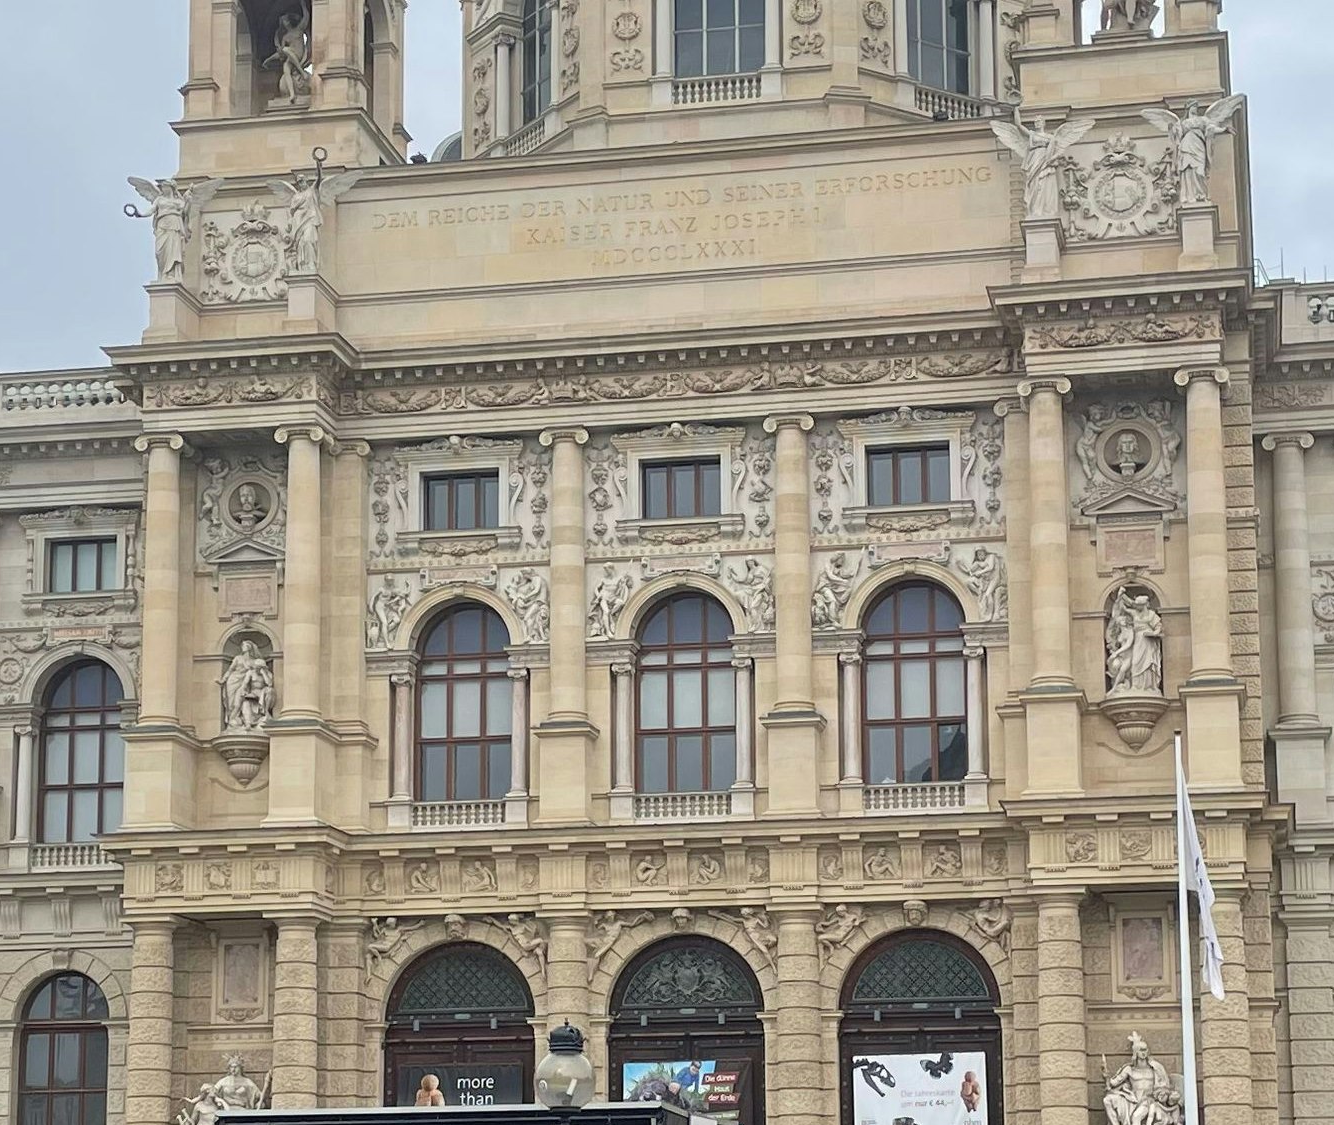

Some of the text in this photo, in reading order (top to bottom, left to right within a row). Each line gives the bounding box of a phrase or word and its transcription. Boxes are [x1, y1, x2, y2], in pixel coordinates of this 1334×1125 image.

[372, 165, 993, 230] DEM REICHE DER NATUR UND SEINER ERFORSCHUNG
[526, 222, 614, 246] KAISER
[624, 214, 698, 239] FRANZ
[710, 208, 806, 232] JOSEPH
[457, 1077, 495, 1089] more
[714, 1084, 730, 1092] Haut
[459, 1091, 494, 1105] than
[720, 1093, 736, 1101] Erde
